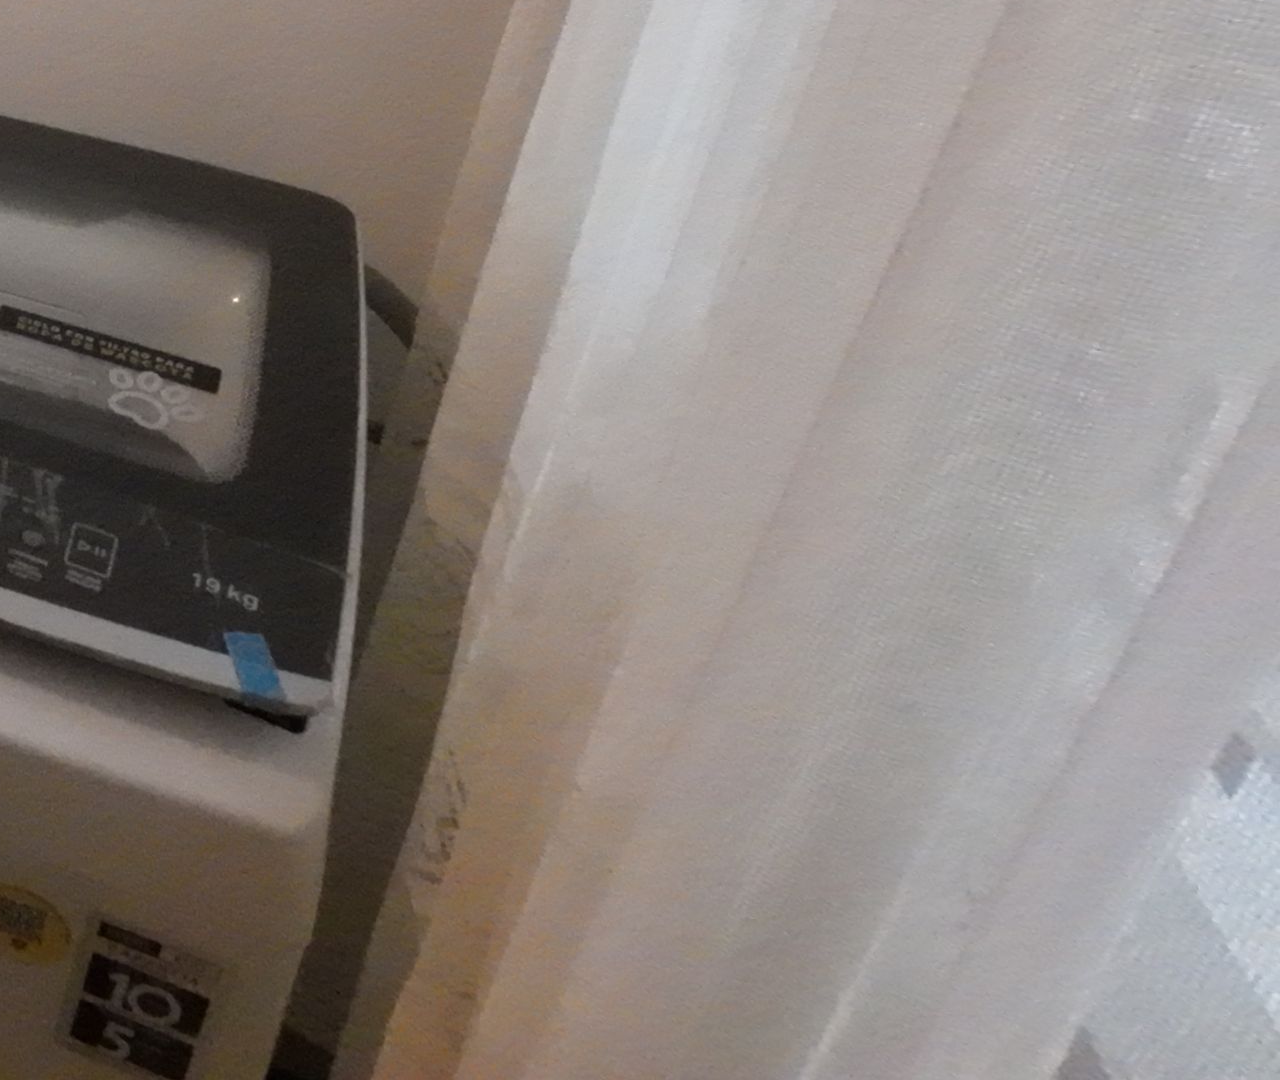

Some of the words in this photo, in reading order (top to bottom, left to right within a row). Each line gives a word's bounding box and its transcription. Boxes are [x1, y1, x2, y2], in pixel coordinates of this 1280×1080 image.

[192, 572, 221, 594] 19
[226, 583, 260, 612] kg
[108, 971, 183, 1027] 10
[99, 1020, 135, 1061] 5
